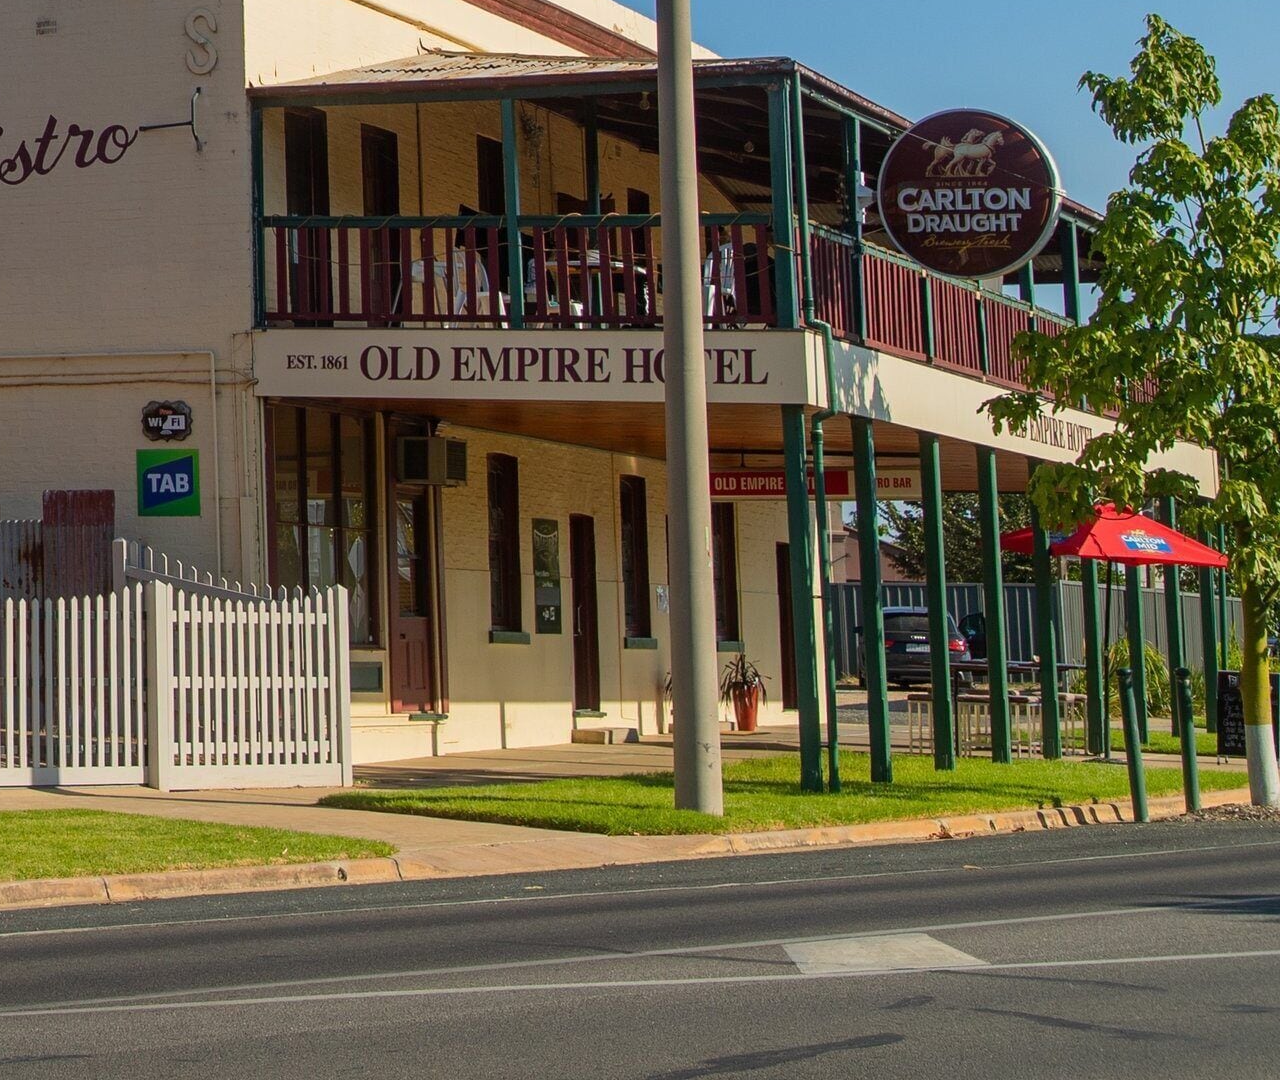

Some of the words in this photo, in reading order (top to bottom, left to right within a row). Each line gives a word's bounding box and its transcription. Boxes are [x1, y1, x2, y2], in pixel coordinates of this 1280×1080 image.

[897, 187, 1032, 212] CARLTON
[906, 213, 1023, 233] DRAUGHT
[286, 354, 317, 370] EST.
[321, 355, 349, 370] 1861
[359, 345, 441, 381] OLD
[450, 346, 612, 384] EMPIRE
[622, 347, 770, 385] HEL
[147, 473, 190, 493] TAB
[714, 476, 737, 491] OLD
[740, 476, 784, 490] EMPIRE
[893, 477, 912, 489] BAR
[1120, 534, 1166, 545] CARLTON
[1136, 542, 1159, 550] MID
